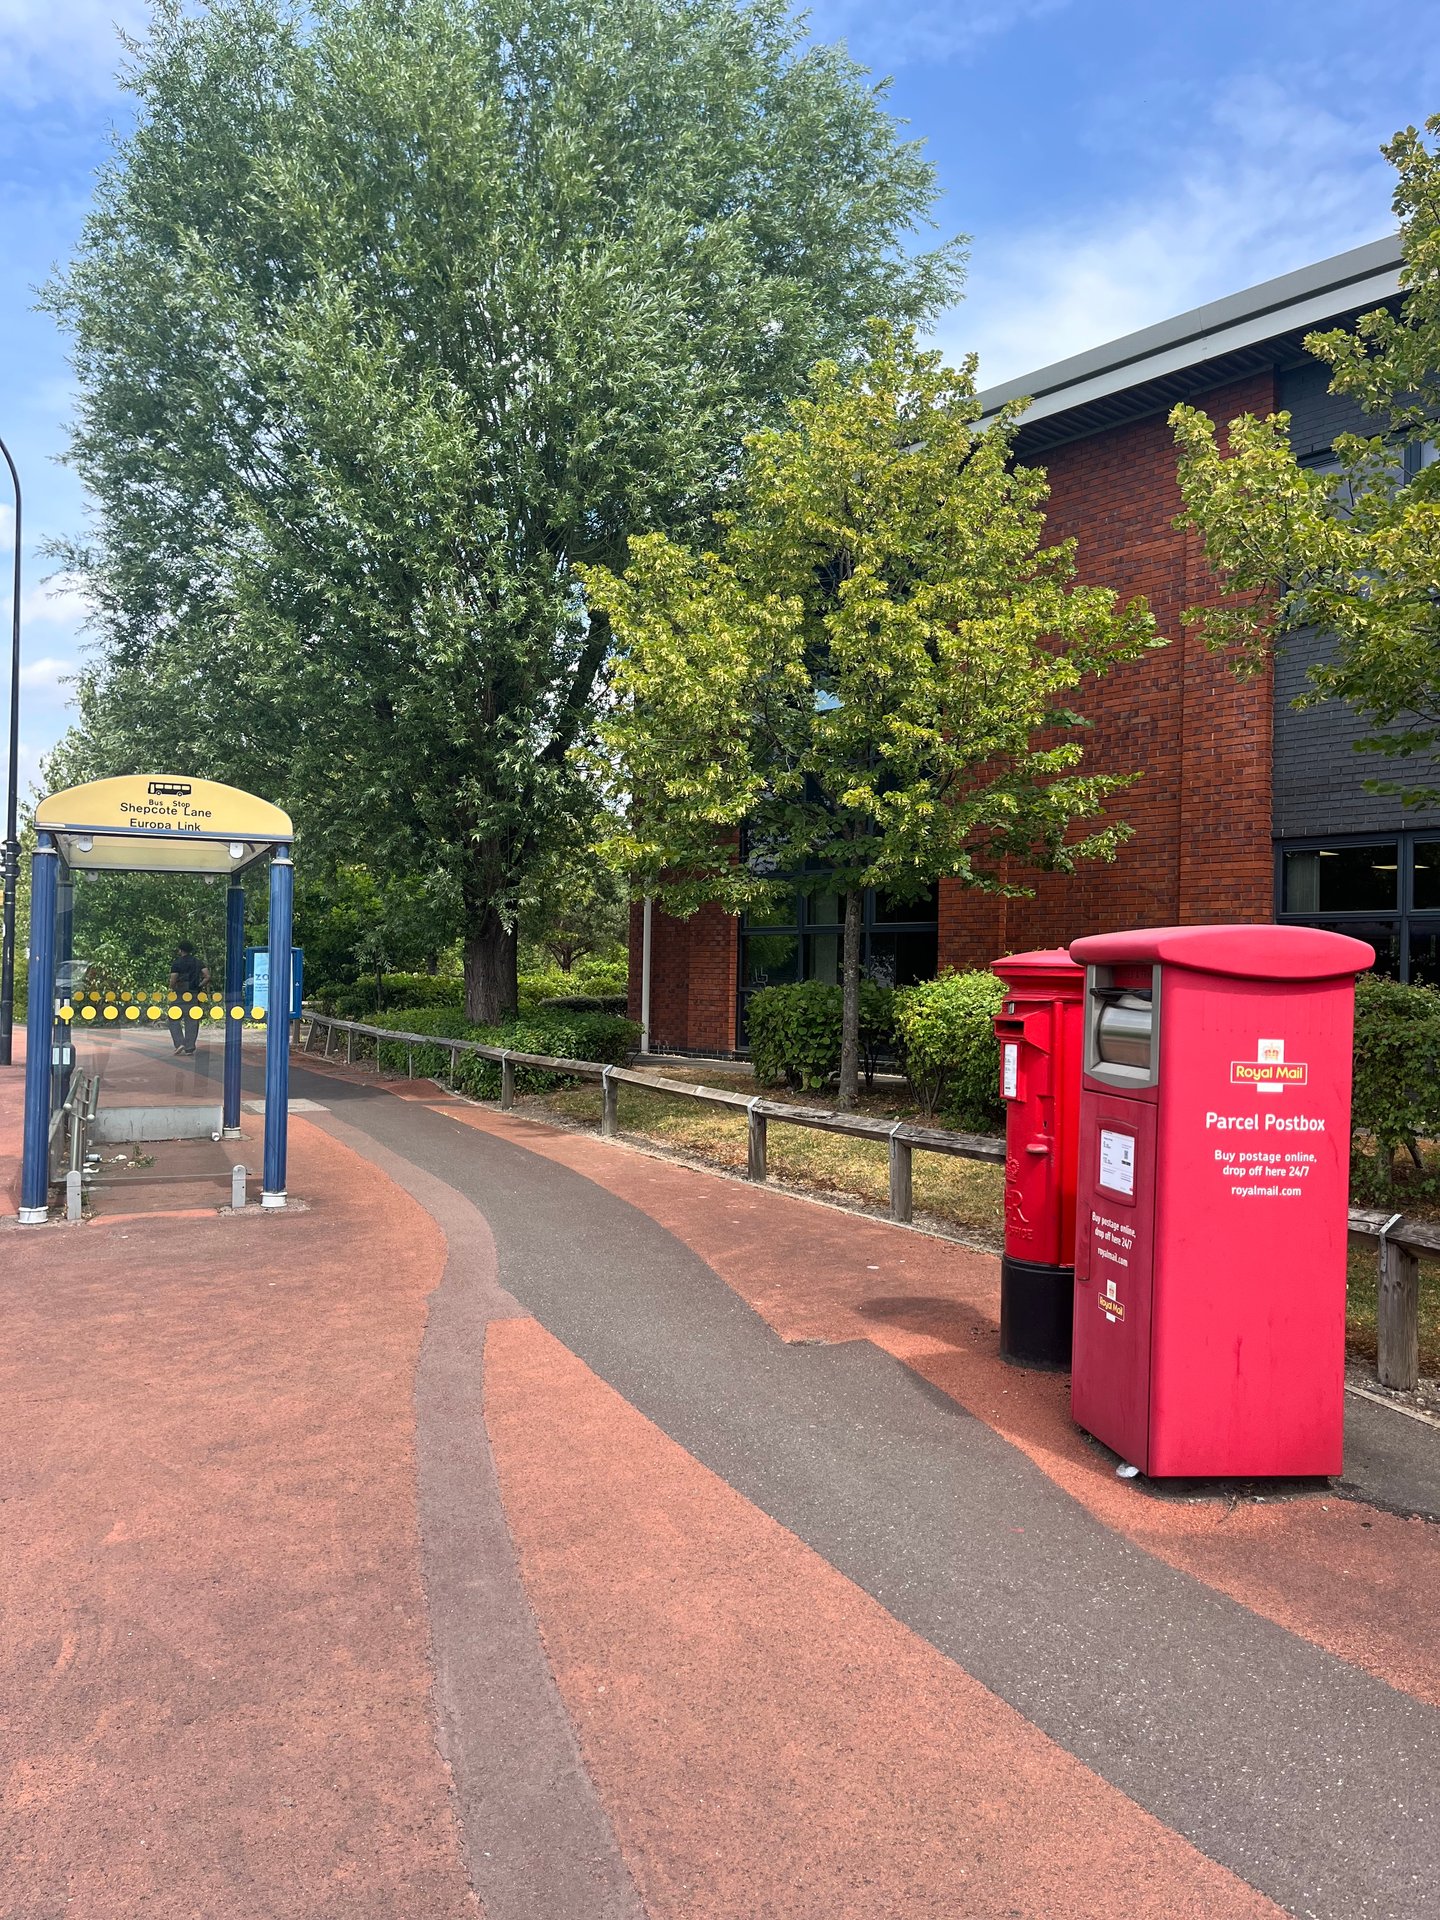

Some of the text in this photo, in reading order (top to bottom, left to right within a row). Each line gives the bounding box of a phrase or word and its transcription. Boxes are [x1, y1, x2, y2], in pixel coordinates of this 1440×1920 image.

[120, 802, 212, 818] Shepcote Lane
[130, 818, 201, 832] Europa Link
[1236, 1066, 1302, 1080] Royal Mail
[1206, 1112, 1325, 1132] Parcel Postbox
[1214, 1150, 1317, 1164] Buy postage online,
[1222, 1165, 1310, 1177] drop off here 24/7
[1231, 1186, 1302, 1197] royalmail.com
[1092, 1212, 1101, 1224] Buy
[1102, 1218, 1120, 1232] postage
[1112, 1233, 1121, 1246] here
[1097, 1247, 1128, 1268] royalmail.com
[1099, 1296, 1122, 1316] Royal Mail
